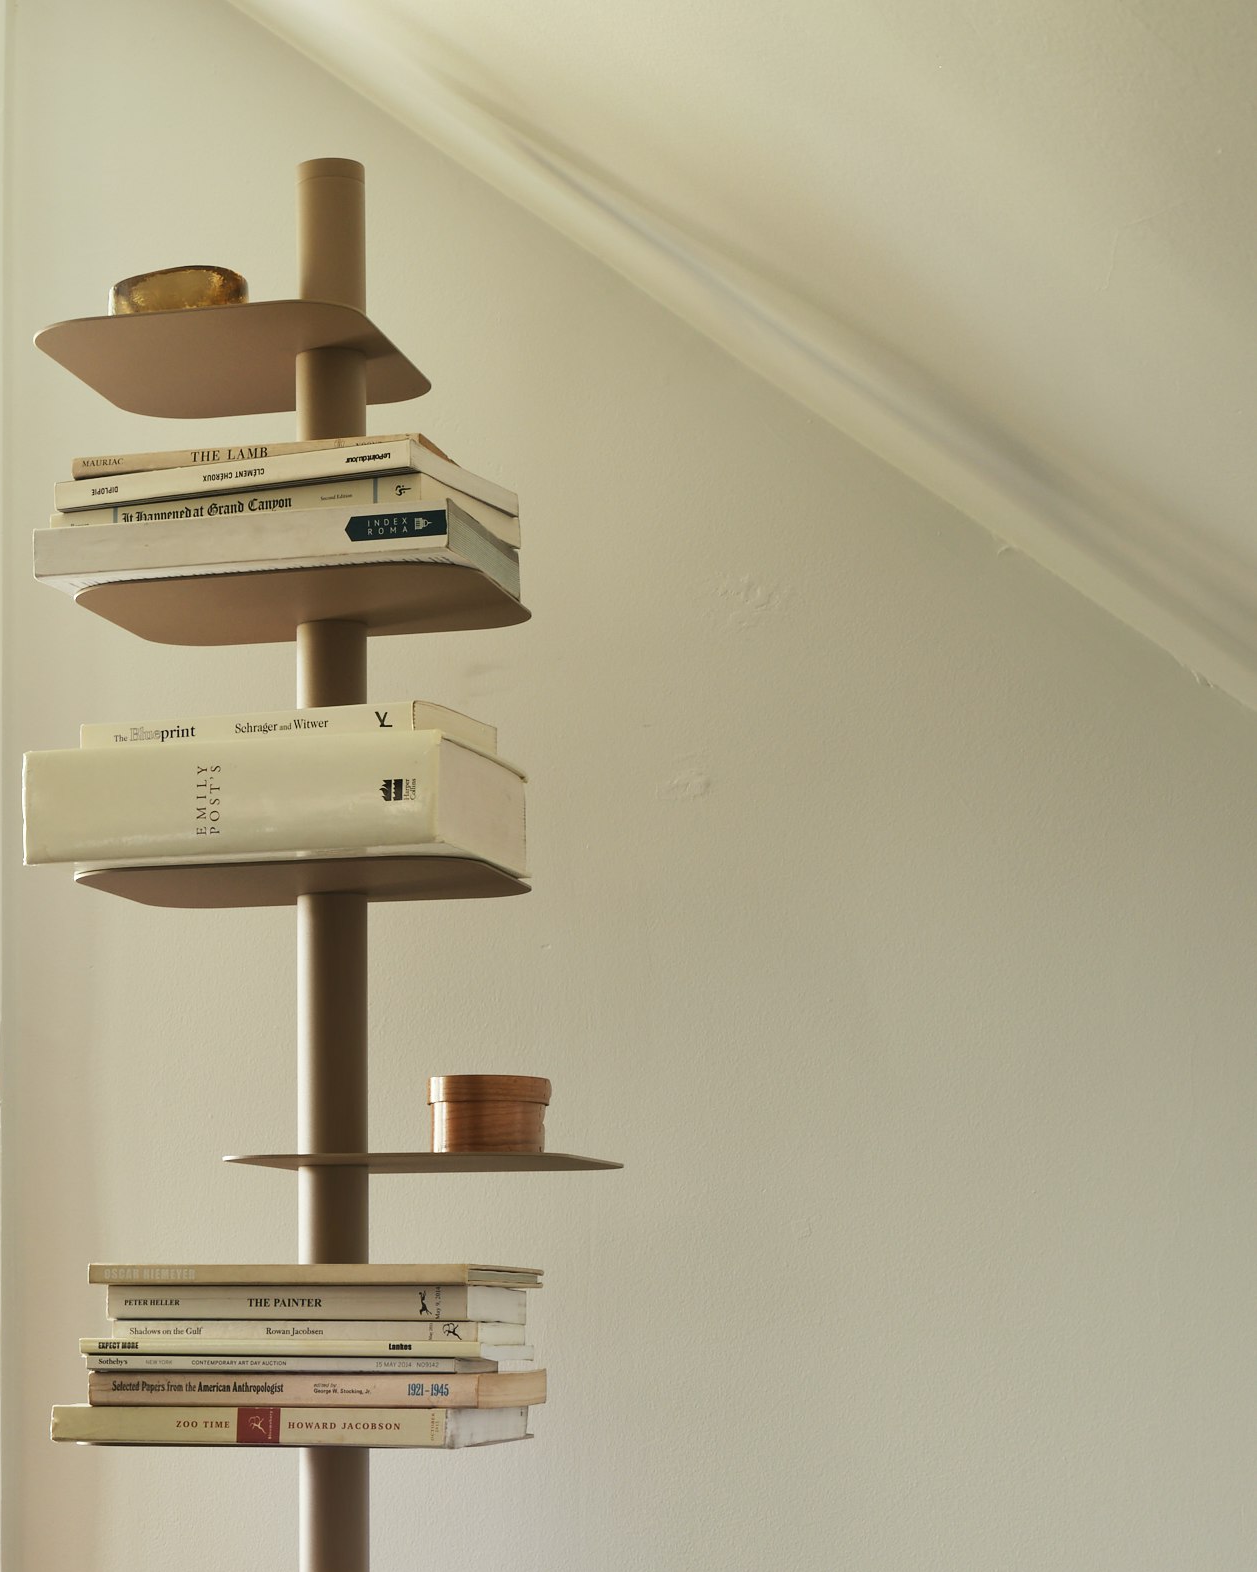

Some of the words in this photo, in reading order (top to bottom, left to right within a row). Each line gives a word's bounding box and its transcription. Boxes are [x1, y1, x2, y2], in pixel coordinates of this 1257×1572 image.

[191, 450, 220, 462] THE
[228, 446, 268, 460] LAMB
[82, 458, 124, 468] MAURIAC
[202, 472, 232, 482] CHÉROUX
[235, 468, 264, 479] CLÉMENT
[92, 486, 118, 496] DIPLOPIE
[122, 512, 134, 522] It
[194, 506, 204, 518] at
[208, 501, 244, 516] Grand
[248, 498, 292, 512] Canyon
[367, 518, 408, 526] INDEX
[367, 527, 408, 535] ROMA
[114, 734, 128, 742] The
[130, 726, 196, 742] Blueprint
[235, 722, 278, 734] Schrager
[293, 719, 329, 730] Witwer
[196, 765, 208, 835] EMILY
[209, 765, 221, 835] POST'S
[103, 1269, 140, 1279] OSCAR
[143, 1269, 196, 1280] NIEMEYER
[247, 1298, 270, 1308] THE
[274, 1298, 322, 1308] PAINTER
[129, 1327, 161, 1335] Shadows
[186, 1327, 204, 1335] Gulf
[291, 1327, 324, 1336] Jacobsen
[98, 1342, 120, 1350] EXPECT
[122, 1342, 139, 1350] MORE
[98, 1358, 128, 1366] Sotheby's
[112, 1380, 140, 1391] Selected
[142, 1381, 165, 1393] Papers
[166, 1381, 183, 1392] from
[185, 1382, 196, 1392] the
[198, 1382, 230, 1392] American
[232, 1382, 284, 1394] Anthropologist
[176, 1420, 198, 1428] ZOO
[288, 1422, 337, 1430] HOWARD
[341, 1422, 401, 1430] JACOBSON
